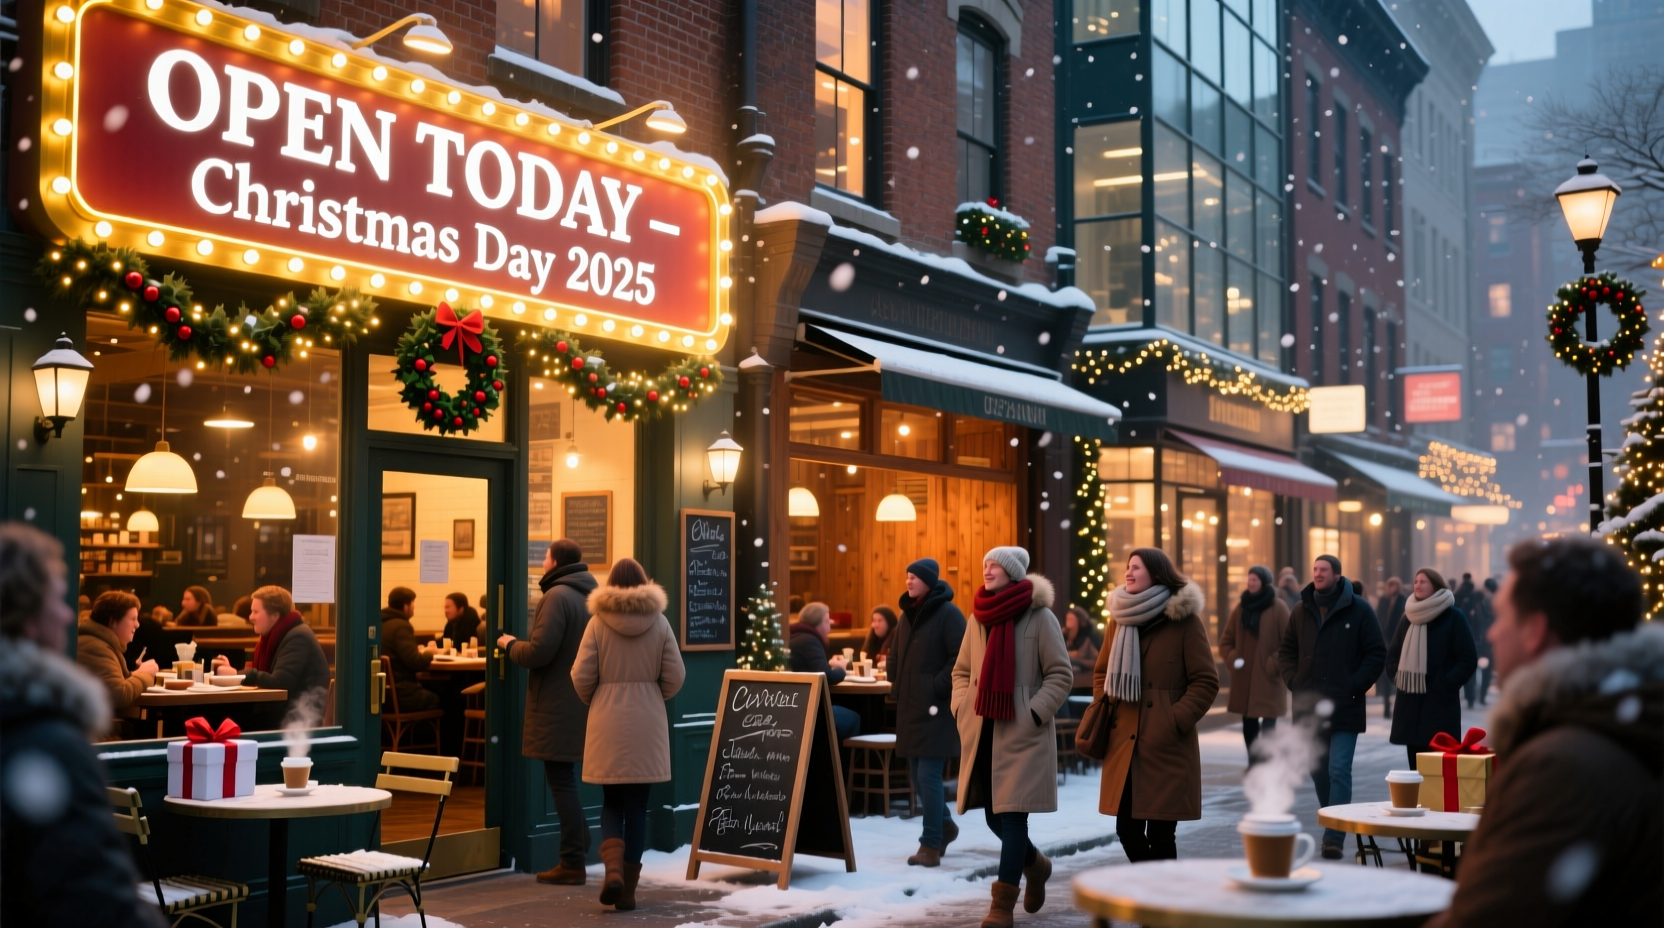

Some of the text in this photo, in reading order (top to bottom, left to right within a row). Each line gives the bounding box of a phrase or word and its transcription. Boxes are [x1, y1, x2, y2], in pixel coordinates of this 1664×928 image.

[147, 48, 397, 182] OPEN
[415, 121, 643, 244] TODAY
[191, 157, 656, 306] Christmas Day 2025
